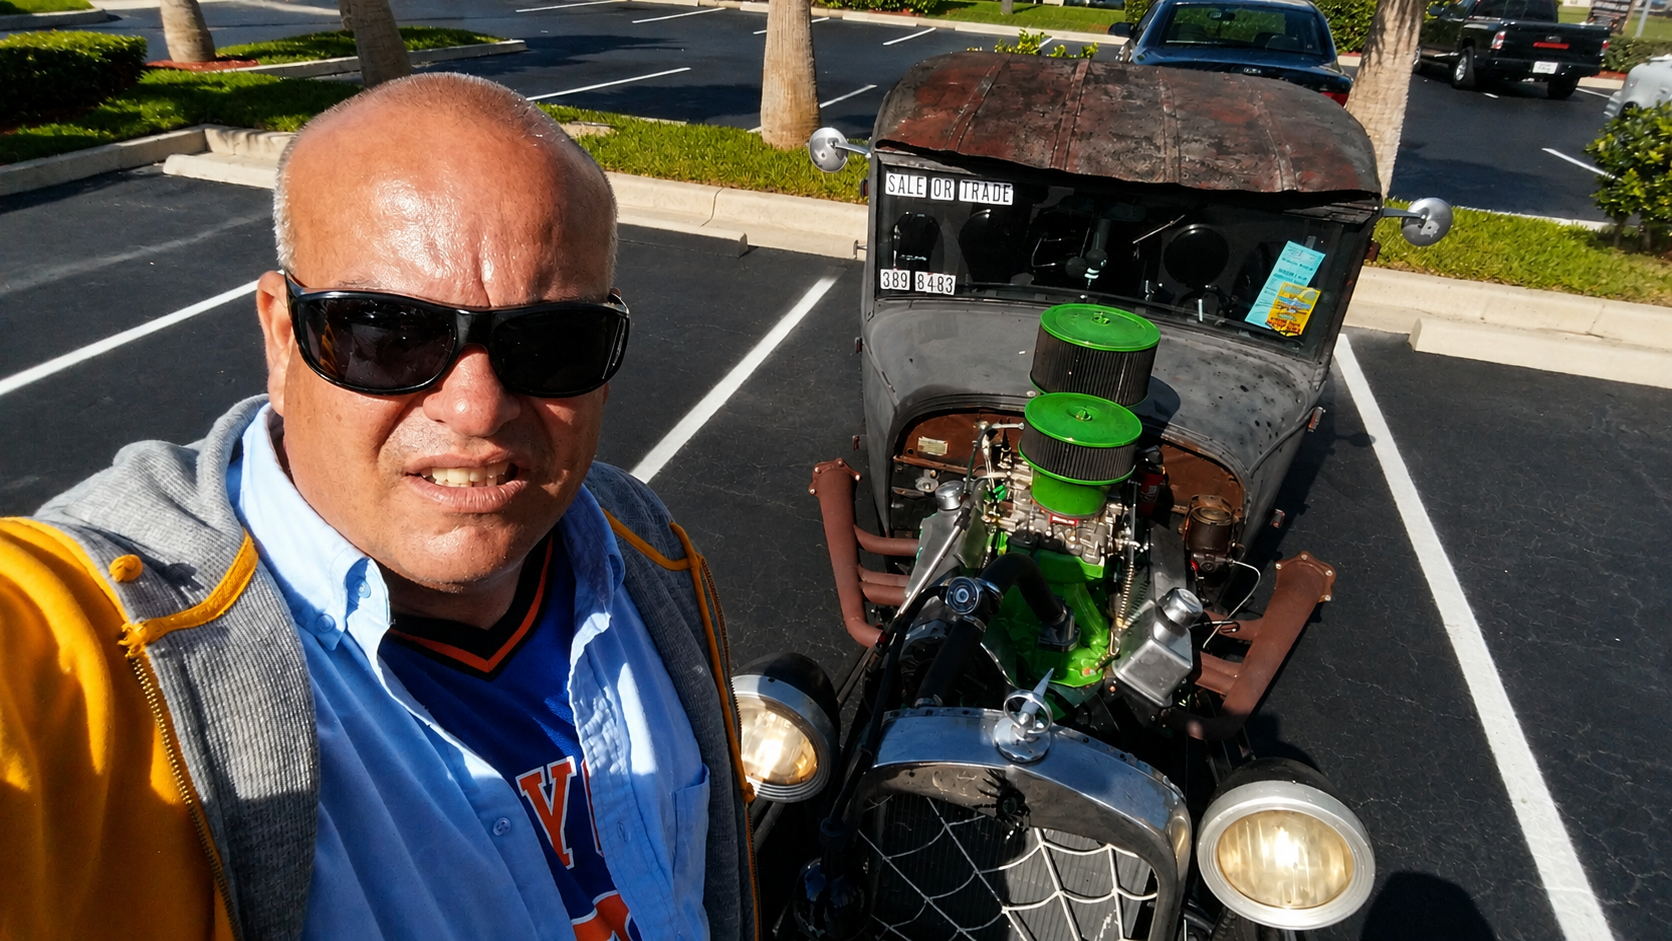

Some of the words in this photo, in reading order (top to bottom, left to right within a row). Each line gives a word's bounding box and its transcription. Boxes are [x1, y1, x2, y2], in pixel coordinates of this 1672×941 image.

[887, 174, 925, 196] SALE
[933, 178, 953, 199] OR
[962, 180, 1011, 203] TRADE
[882, 271, 908, 289] 389
[916, 273, 954, 294] 8483
[515, 755, 604, 870] Y
